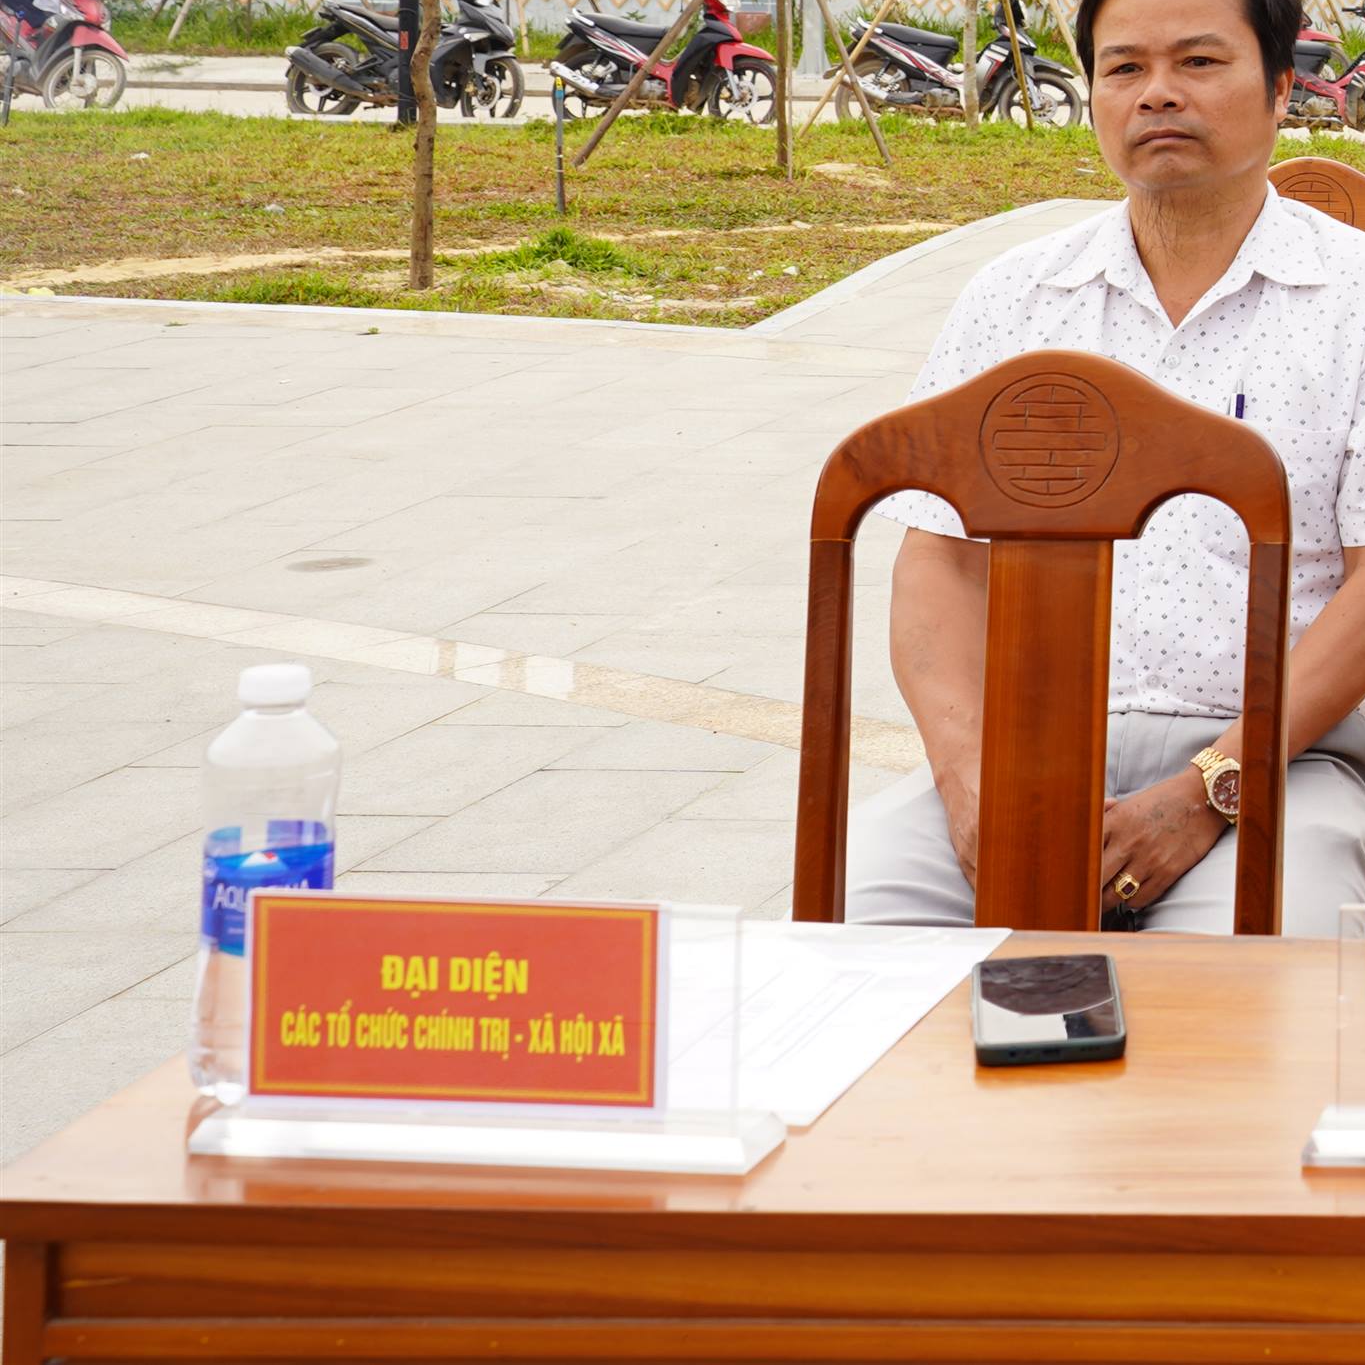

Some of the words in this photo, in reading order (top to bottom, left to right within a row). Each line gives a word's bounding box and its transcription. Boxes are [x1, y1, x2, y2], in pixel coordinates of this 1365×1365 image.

[380, 954, 439, 999] ĐẠI
[449, 951, 529, 1001] DIỆN
[280, 1004, 322, 1047] CÁC
[325, 999, 353, 1048] TỔ
[355, 1007, 409, 1050] CHỨC
[413, 1008, 475, 1052] CHÍNH
[479, 1017, 511, 1060] TRỊ
[528, 1012, 556, 1054] XÃ
[560, 1012, 594, 1063] HỘI
[598, 1014, 626, 1057] XÃ
